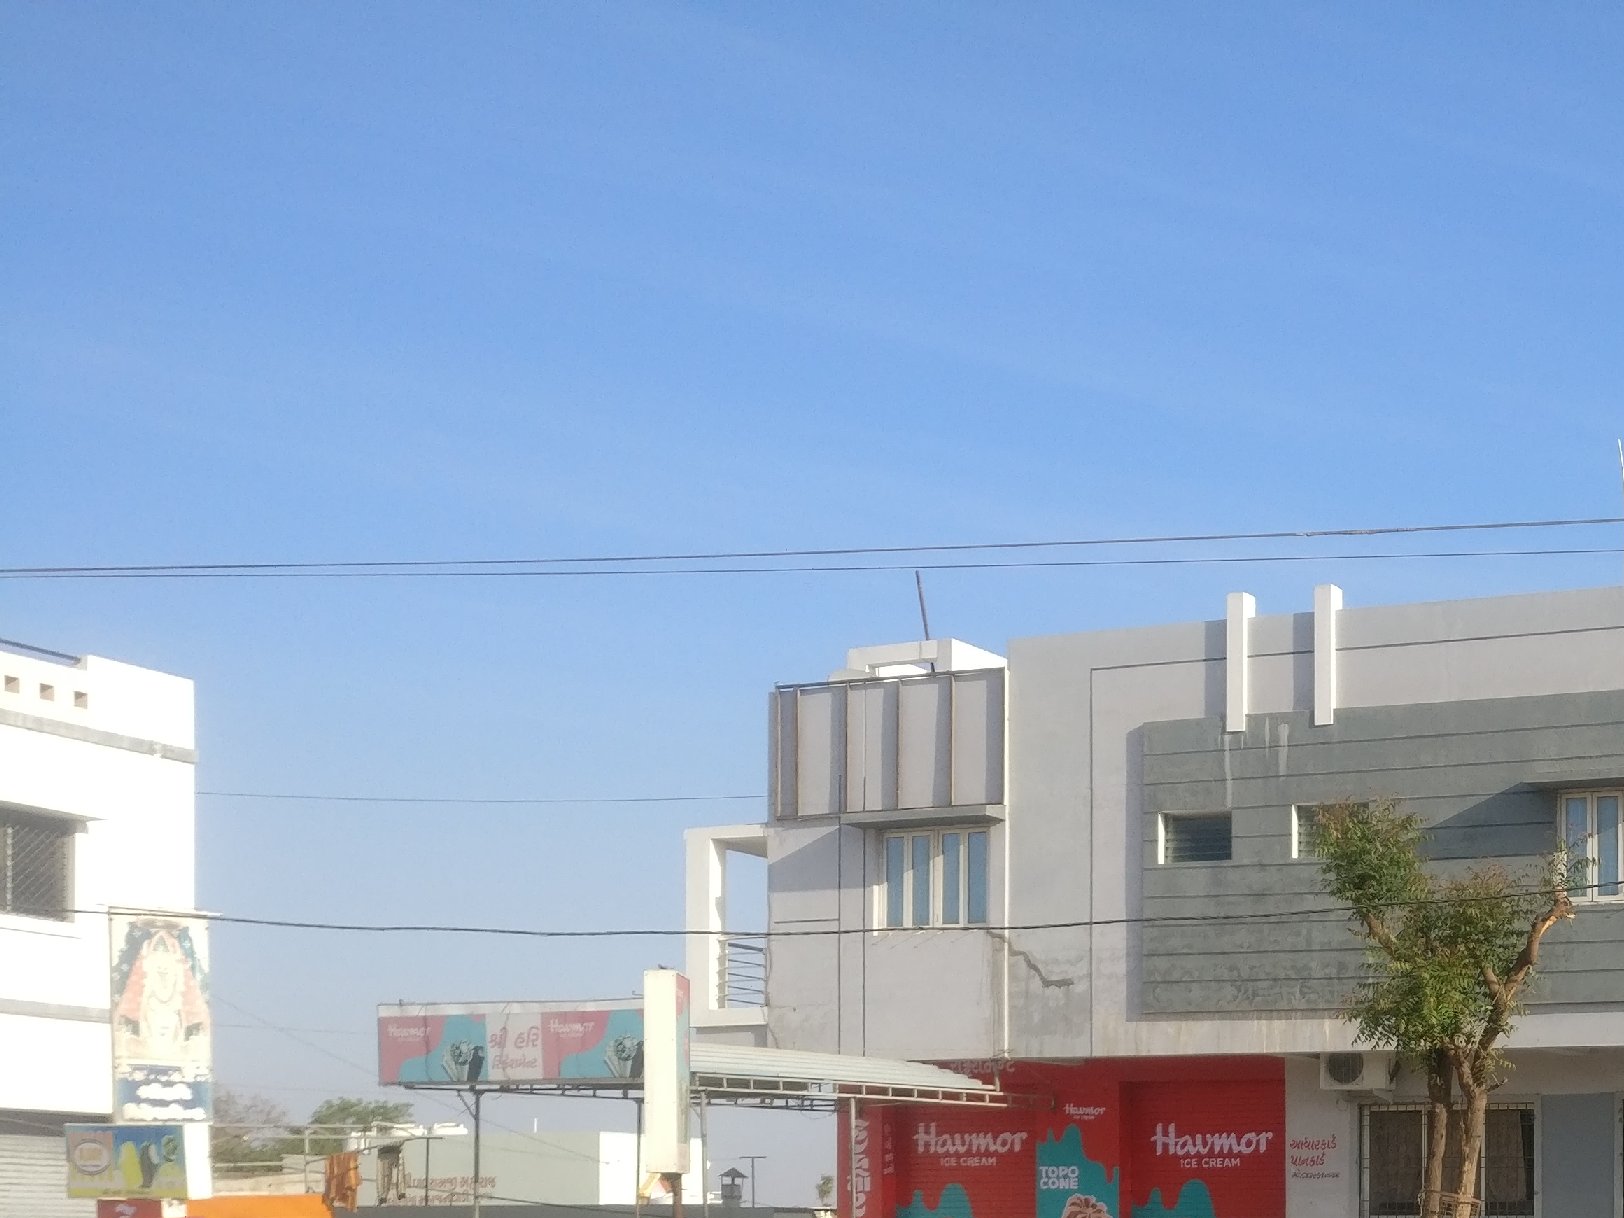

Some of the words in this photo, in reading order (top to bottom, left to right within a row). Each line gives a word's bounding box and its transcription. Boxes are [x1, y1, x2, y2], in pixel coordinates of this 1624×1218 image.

[1063, 1103, 1106, 1115] Havmor
[912, 1121, 1028, 1154] Havmor
[1150, 1122, 1273, 1155] Havmor
[960, 1157, 997, 1167] CREAM
[1180, 1158, 1198, 1168] ICE
[1202, 1158, 1241, 1168] CREAM
[1039, 1166, 1079, 1178] TOPO
[1039, 1178, 1079, 1189] CONE
